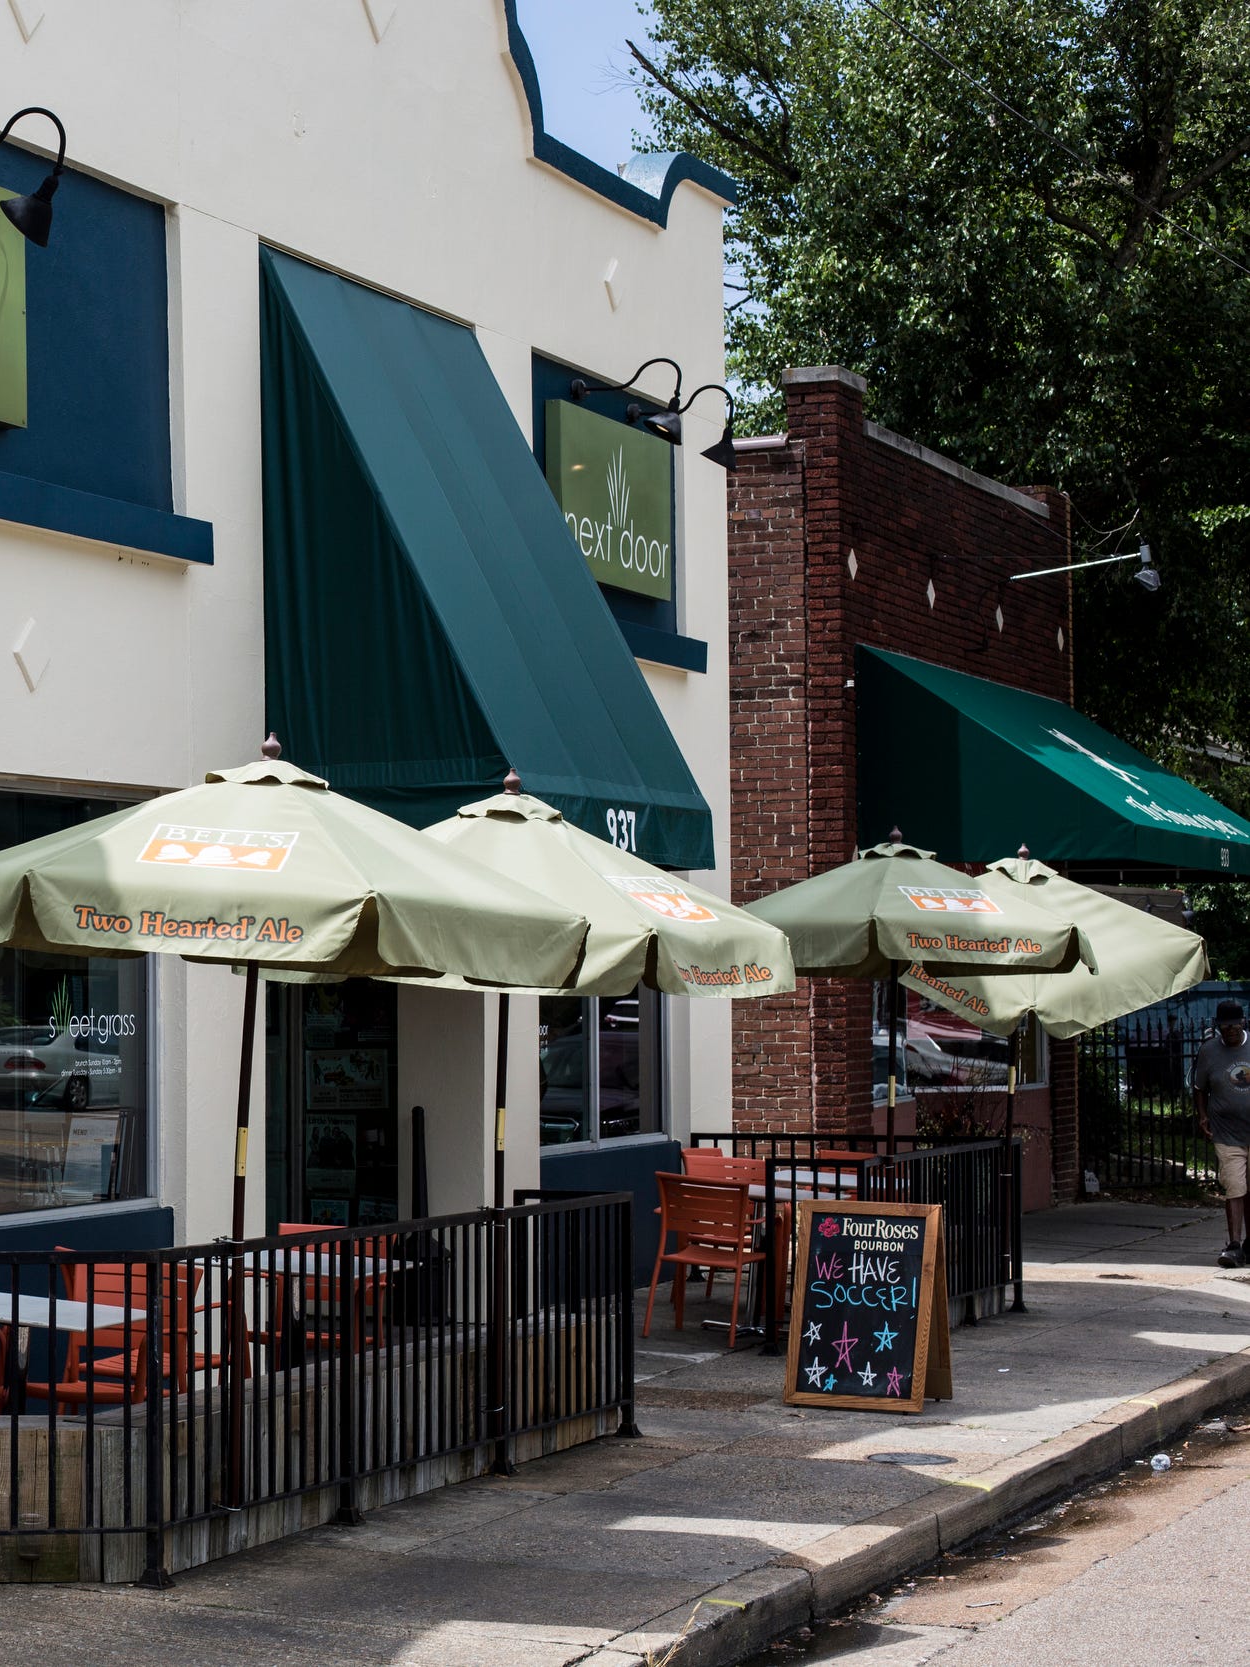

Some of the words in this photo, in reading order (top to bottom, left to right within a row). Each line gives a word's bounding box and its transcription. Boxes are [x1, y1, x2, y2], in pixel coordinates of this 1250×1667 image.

[564, 511, 613, 562] next
[619, 519, 669, 578] door
[164, 827, 286, 849] BELL'S
[606, 807, 637, 852] 937
[73, 904, 132, 933] Two
[139, 911, 251, 941] Hearted
[256, 917, 304, 944] Ale
[906, 933, 942, 949] Two
[945, 935, 1011, 953] Hearted
[1013, 938, 1042, 954] Ale
[690, 965, 740, 986] Hearted
[744, 963, 773, 985] Ale
[908, 963, 968, 1002] Hearted
[964, 996, 990, 1016] Ale
[97, 1014, 136, 1044] grass
[854, 1240, 904, 1253] BOURBON
[815, 1252, 844, 1281] WE
[847, 1251, 901, 1285] HAVE
[810, 1276, 918, 1320] SOCCER!
